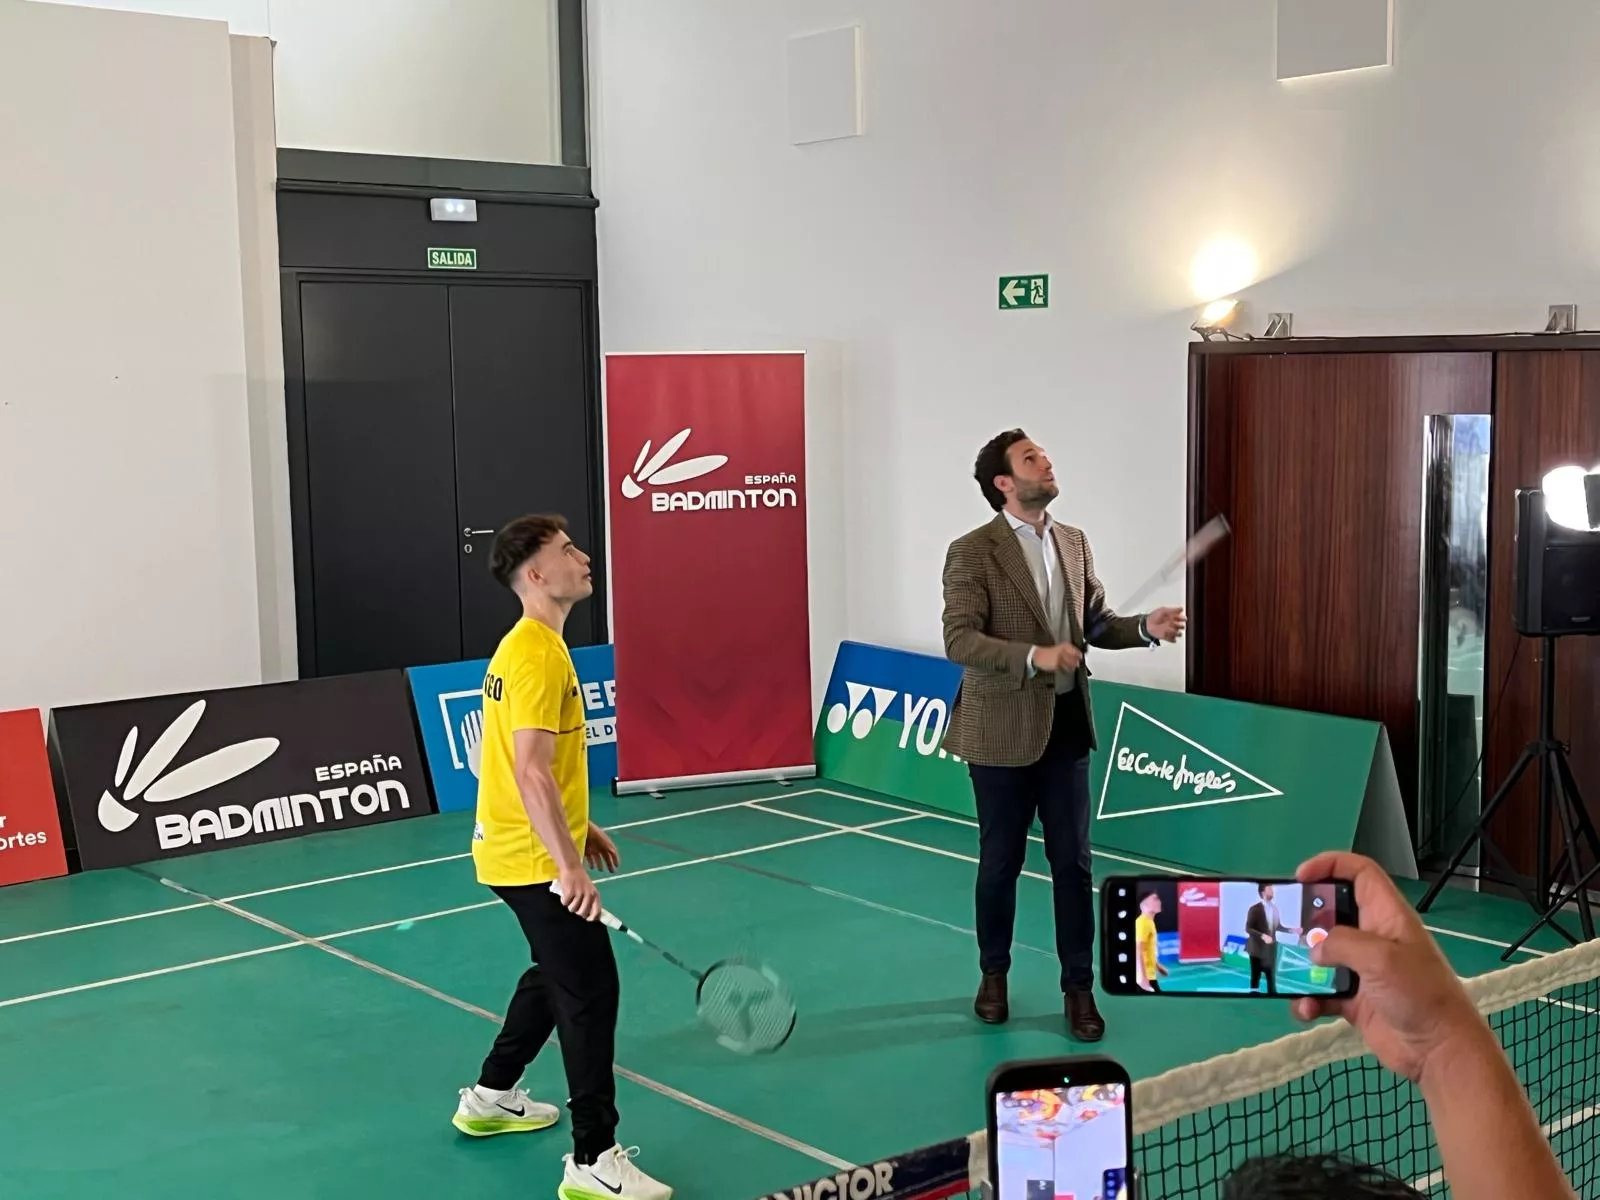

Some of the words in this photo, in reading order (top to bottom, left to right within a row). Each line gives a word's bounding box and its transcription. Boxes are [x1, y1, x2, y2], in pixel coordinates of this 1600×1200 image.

[432, 251, 472, 266] SALIDA
[744, 472, 797, 485] ESPAÑA
[651, 488, 797, 512] BADMINTON
[603, 724, 616, 736] D
[315, 754, 403, 782] ESPAÑA
[1117, 747, 1135, 772] El
[1134, 752, 1175, 781] Corte
[1173, 754, 1237, 795] Inglés
[155, 779, 411, 850] BADMINTON
